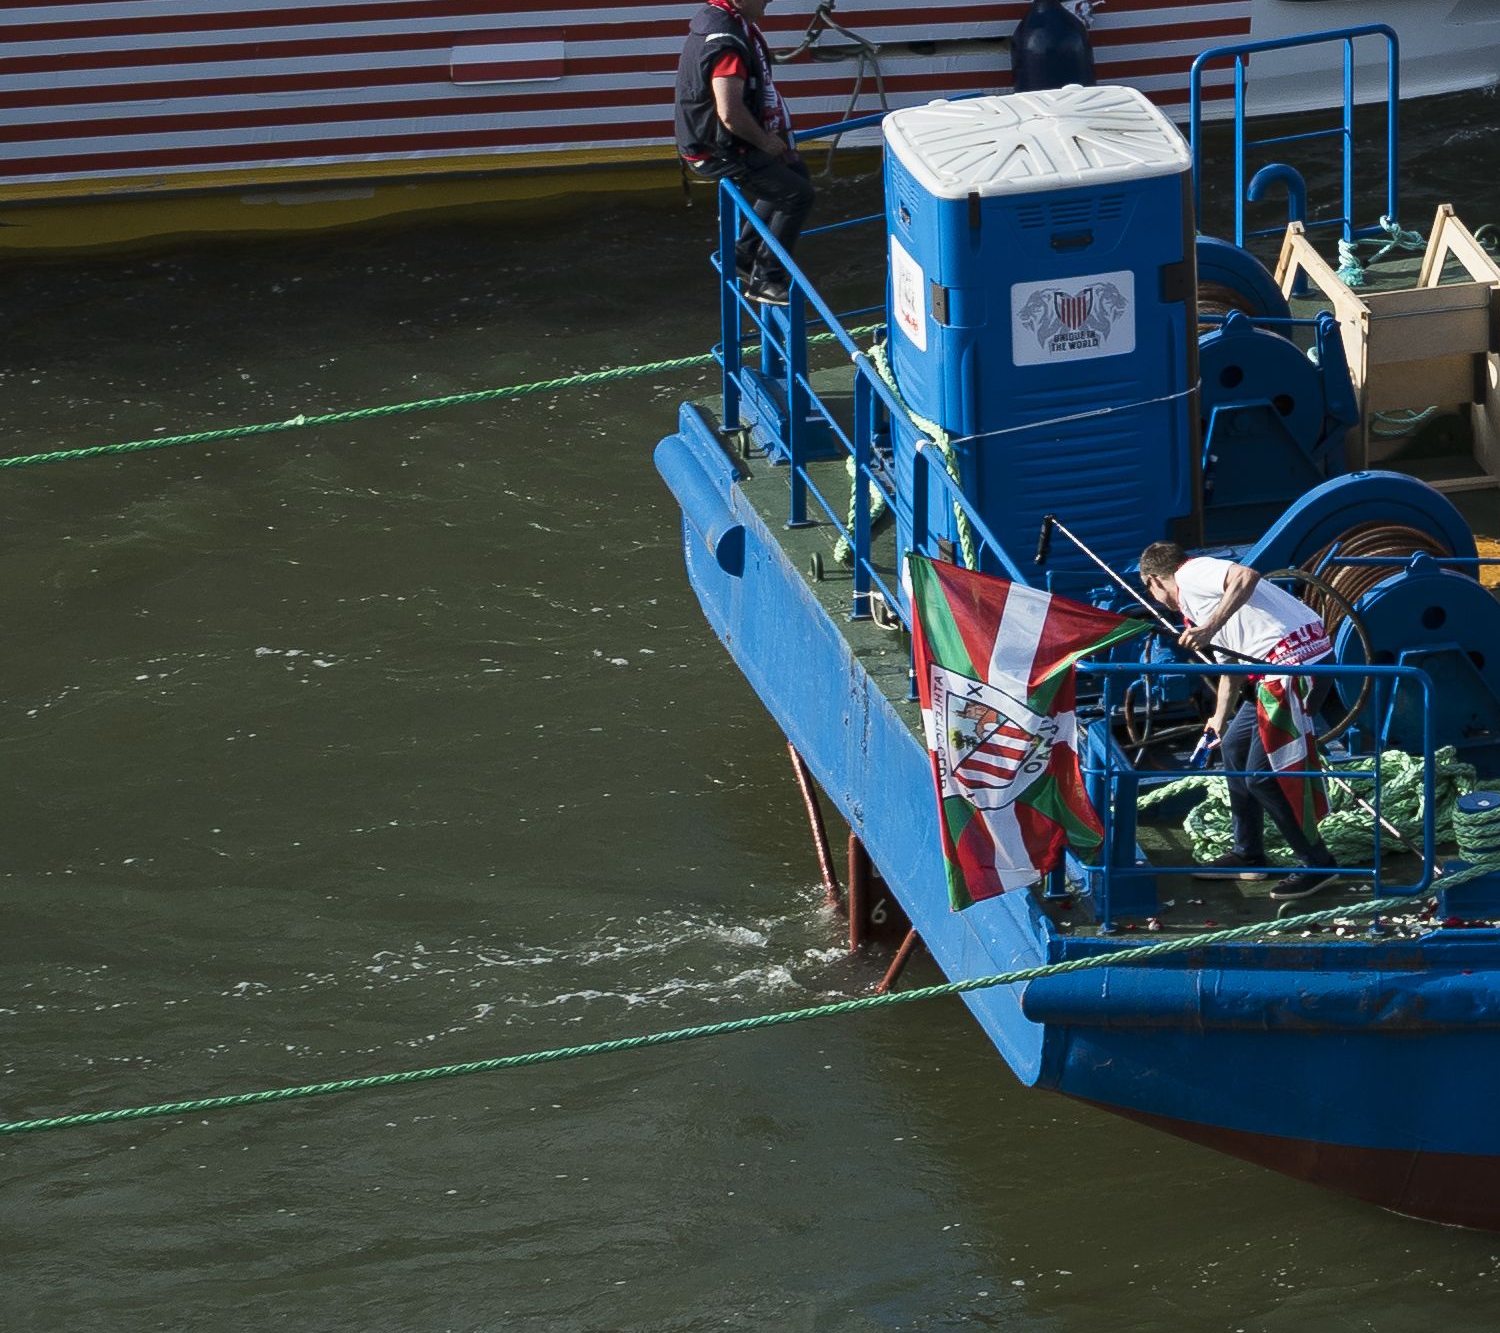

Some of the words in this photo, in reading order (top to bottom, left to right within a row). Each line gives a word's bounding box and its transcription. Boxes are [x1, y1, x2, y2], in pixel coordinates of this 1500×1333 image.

[1050, 341, 1067, 352] THE
[1068, 338, 1099, 351] WORLD
[871, 897, 888, 925] 6
